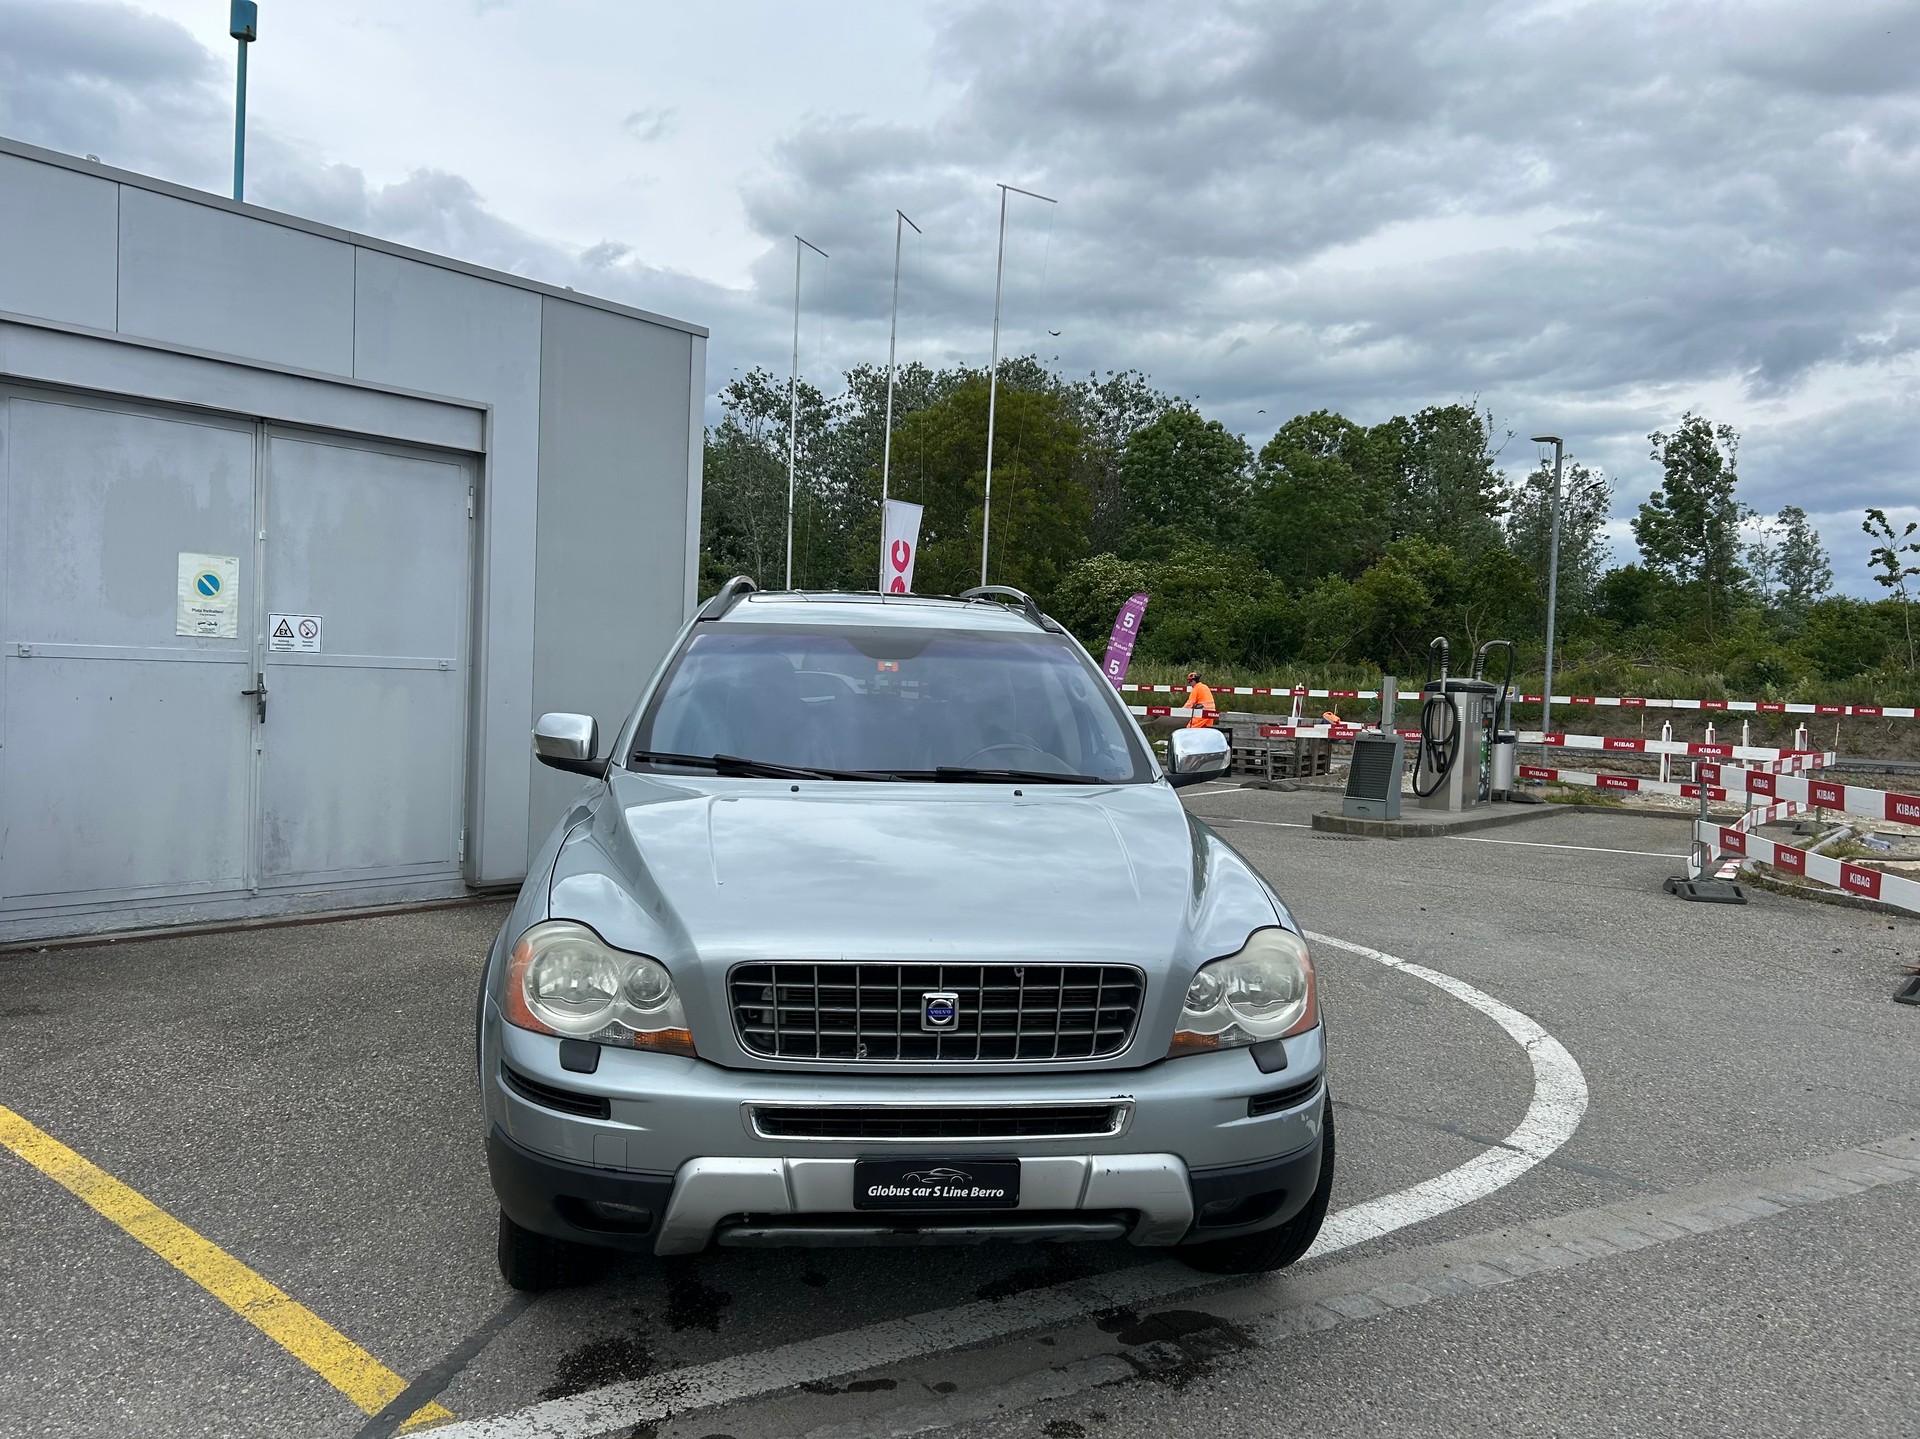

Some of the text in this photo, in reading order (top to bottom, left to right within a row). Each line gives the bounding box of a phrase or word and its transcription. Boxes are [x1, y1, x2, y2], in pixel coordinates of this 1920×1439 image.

[1123, 612, 1135, 629] 5
[279, 628, 289, 636] EX
[1108, 659, 1120, 675] 5
[1698, 747, 1722, 755] KIBAG
[1528, 769, 1549, 778] KIBAG
[1701, 768, 1715, 779] KIBAG
[1606, 779, 1628, 787] KIBAG
[1752, 778, 1769, 790] KIBAG
[1816, 789, 1836, 802] KIBAG
[1896, 803, 1920, 818] KIBAG
[1725, 835, 1740, 847] KIBAG
[1780, 851, 1798, 866] KIBAG
[1849, 872, 1871, 889] KIBAG
[867, 1185, 1004, 1198] Globus car S Line Berro
